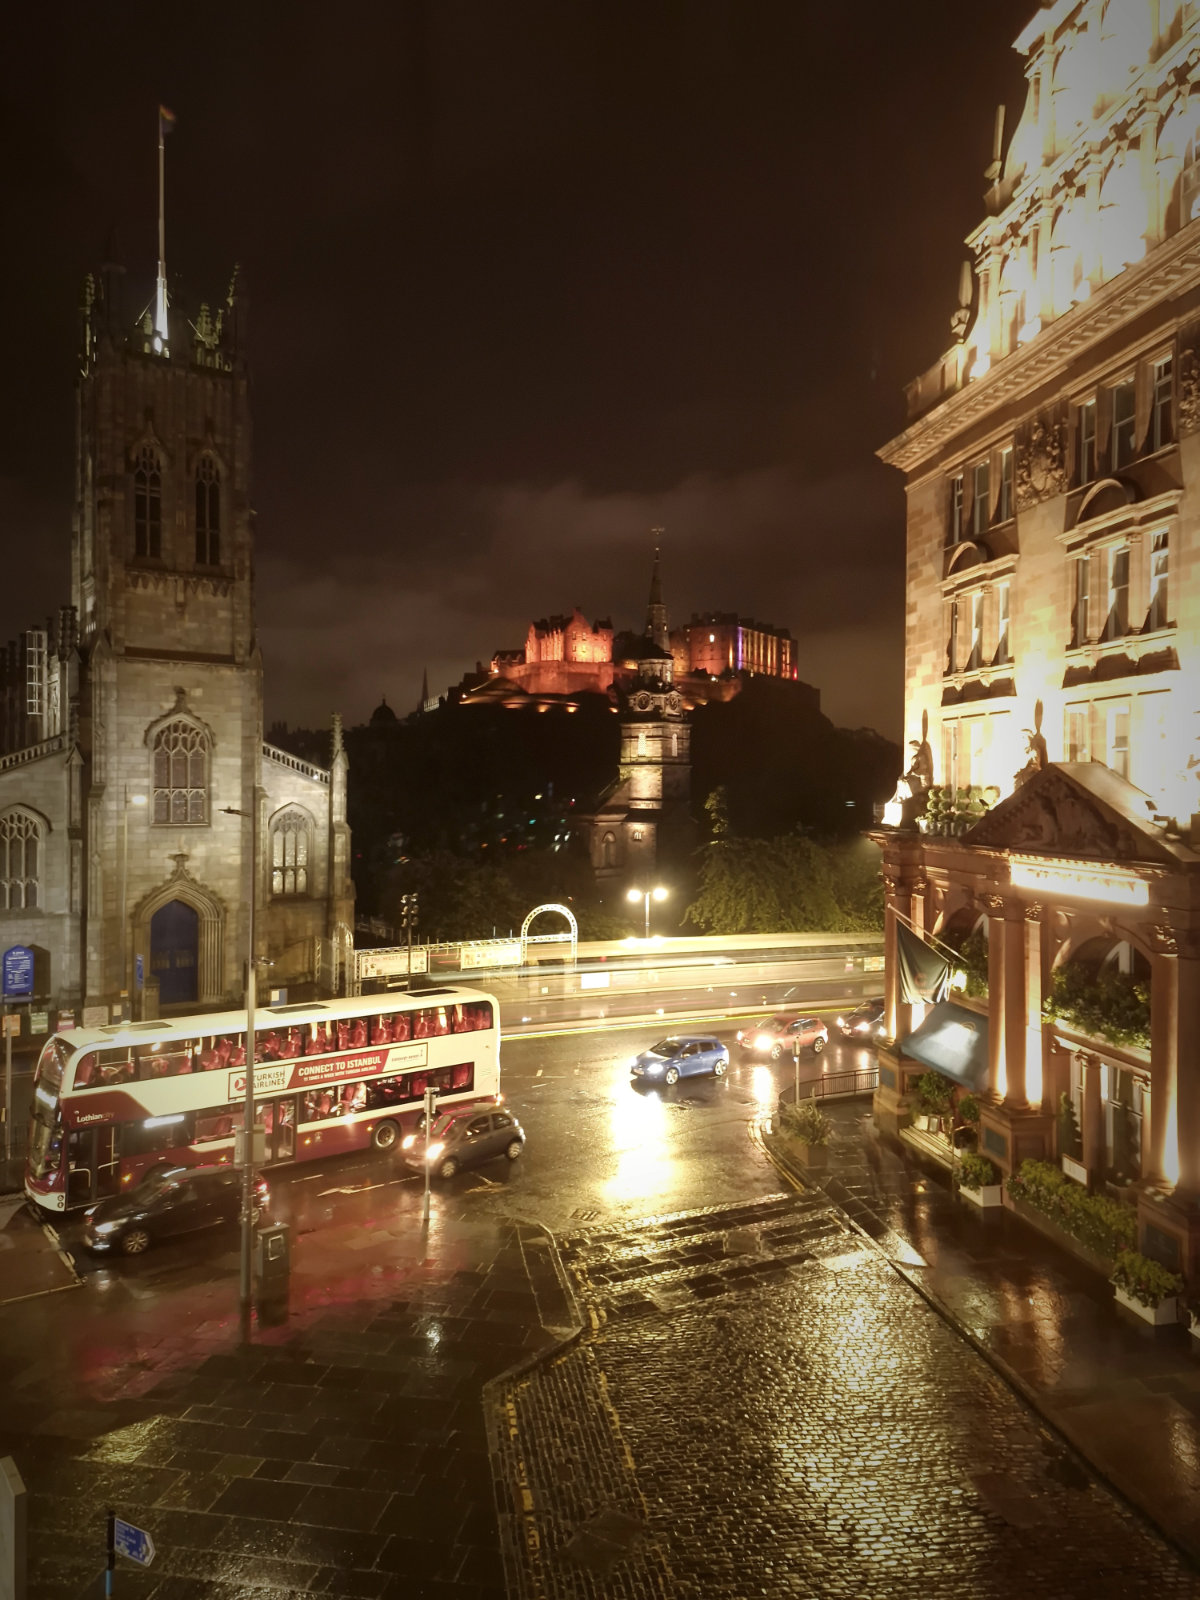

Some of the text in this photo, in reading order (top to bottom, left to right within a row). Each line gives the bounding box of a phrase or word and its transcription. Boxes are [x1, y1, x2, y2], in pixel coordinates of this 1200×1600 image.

[299, 1056, 381, 1076] CONNECT TO ISTANBUL
